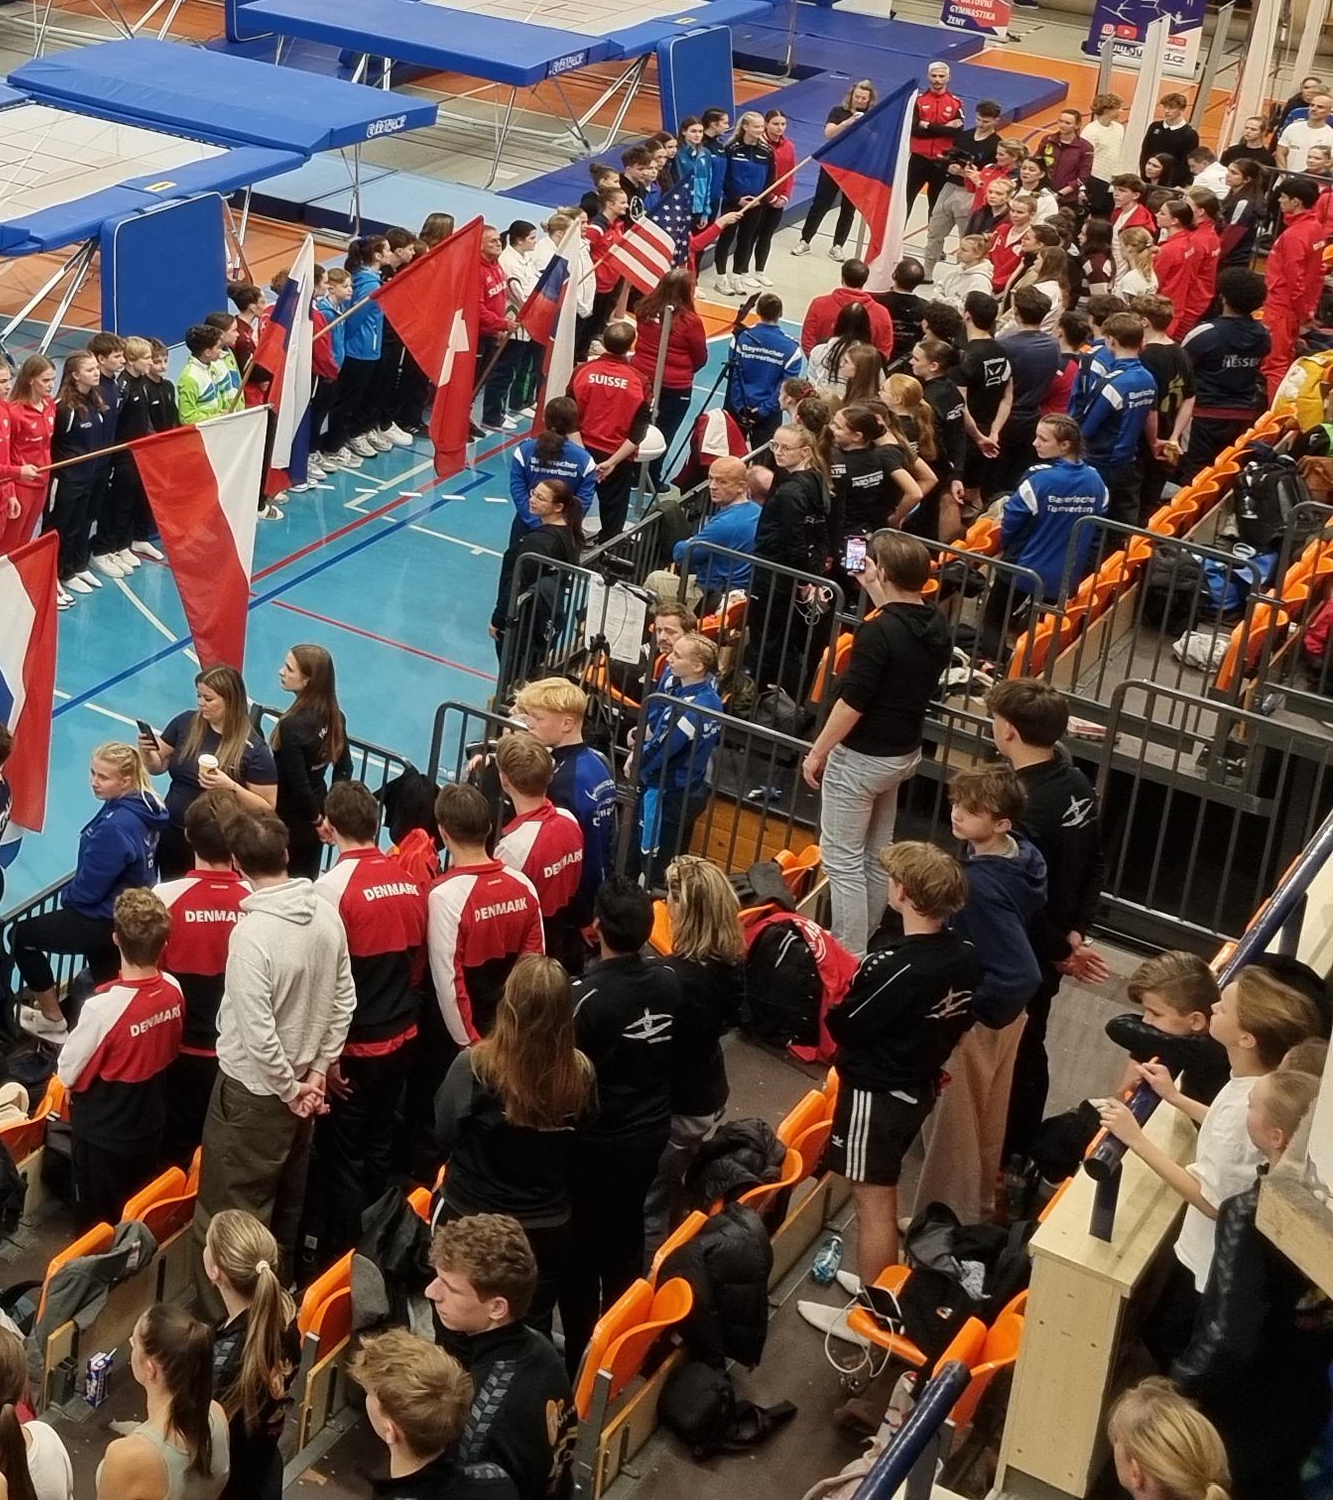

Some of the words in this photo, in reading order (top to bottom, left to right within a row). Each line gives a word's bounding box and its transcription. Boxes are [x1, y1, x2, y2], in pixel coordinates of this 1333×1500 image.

[946, 14, 966, 27] ŽENY
[949, 4, 996, 21] GYMNASTIKA
[587, 372, 629, 390] SUISSE
[363, 881, 421, 902] DENMARK
[474, 896, 529, 923] DENMARK
